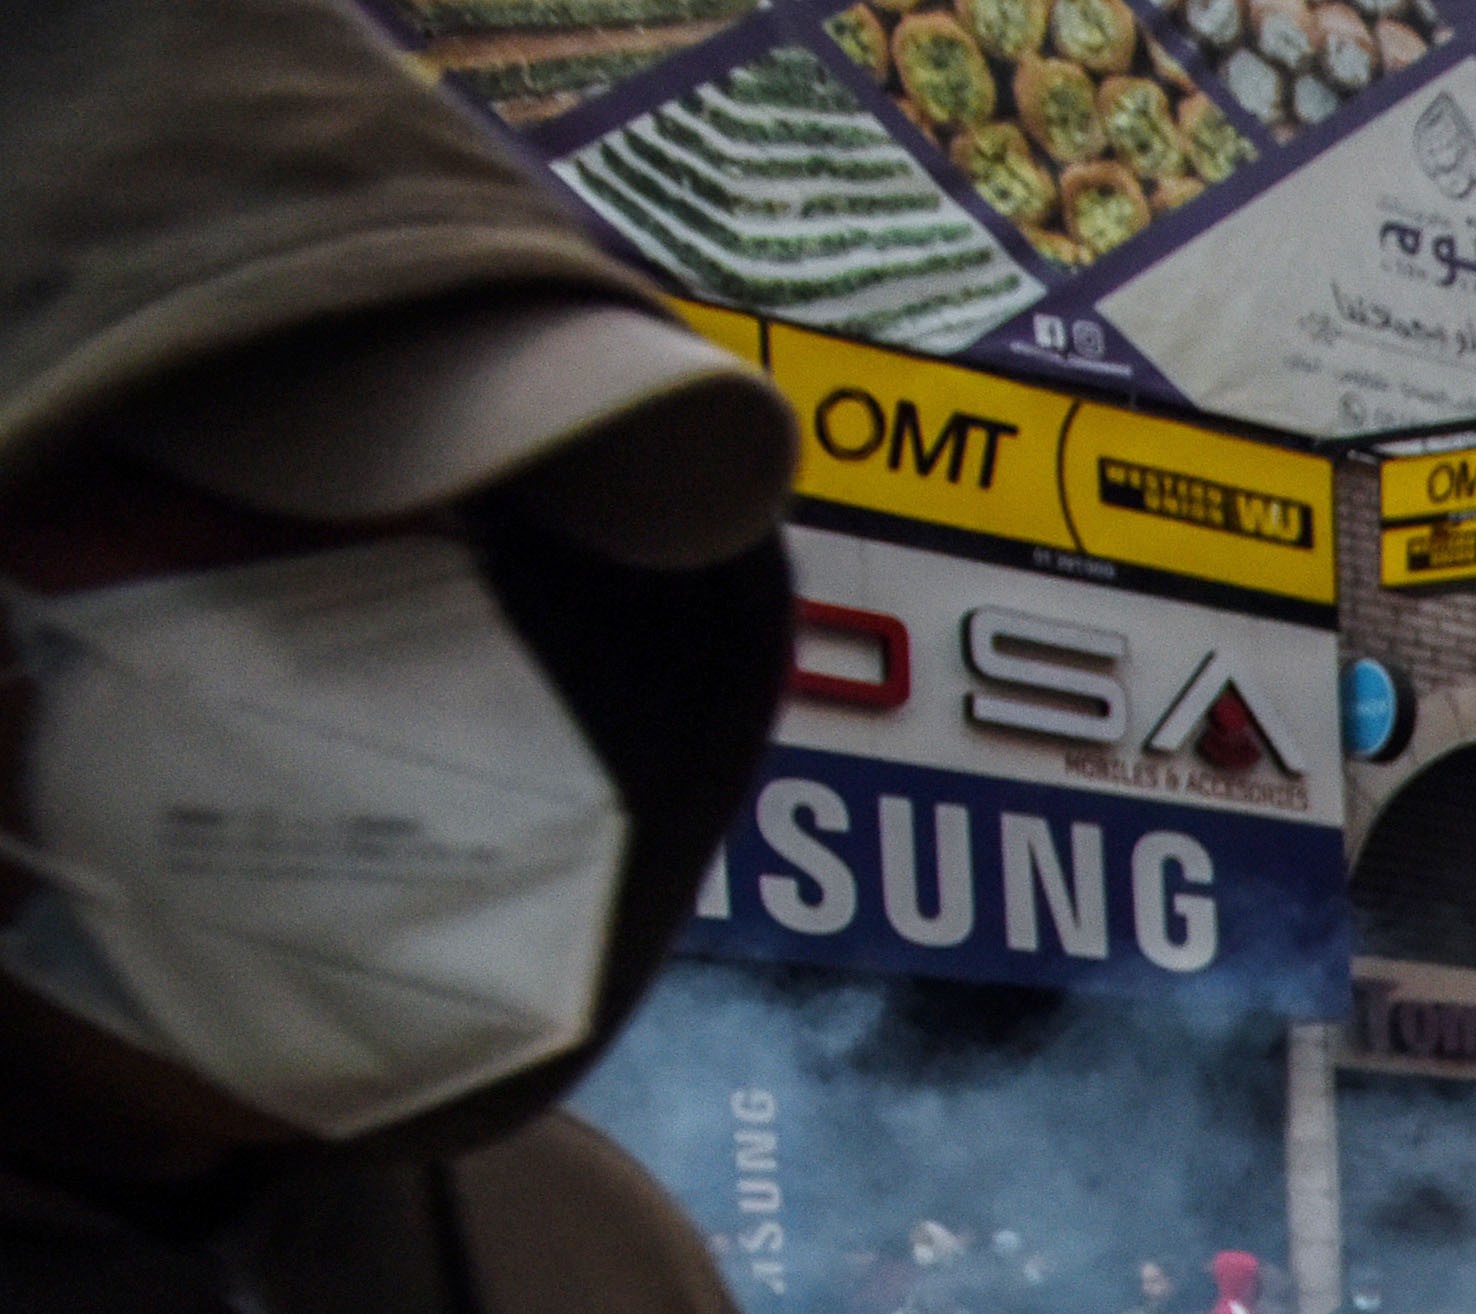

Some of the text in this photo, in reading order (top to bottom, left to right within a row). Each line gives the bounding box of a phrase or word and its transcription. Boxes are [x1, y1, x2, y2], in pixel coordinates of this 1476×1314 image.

[815, 387, 1018, 489] OMT
[1234, 494, 1300, 542] WU
[696, 777, 1220, 973] SUNG
